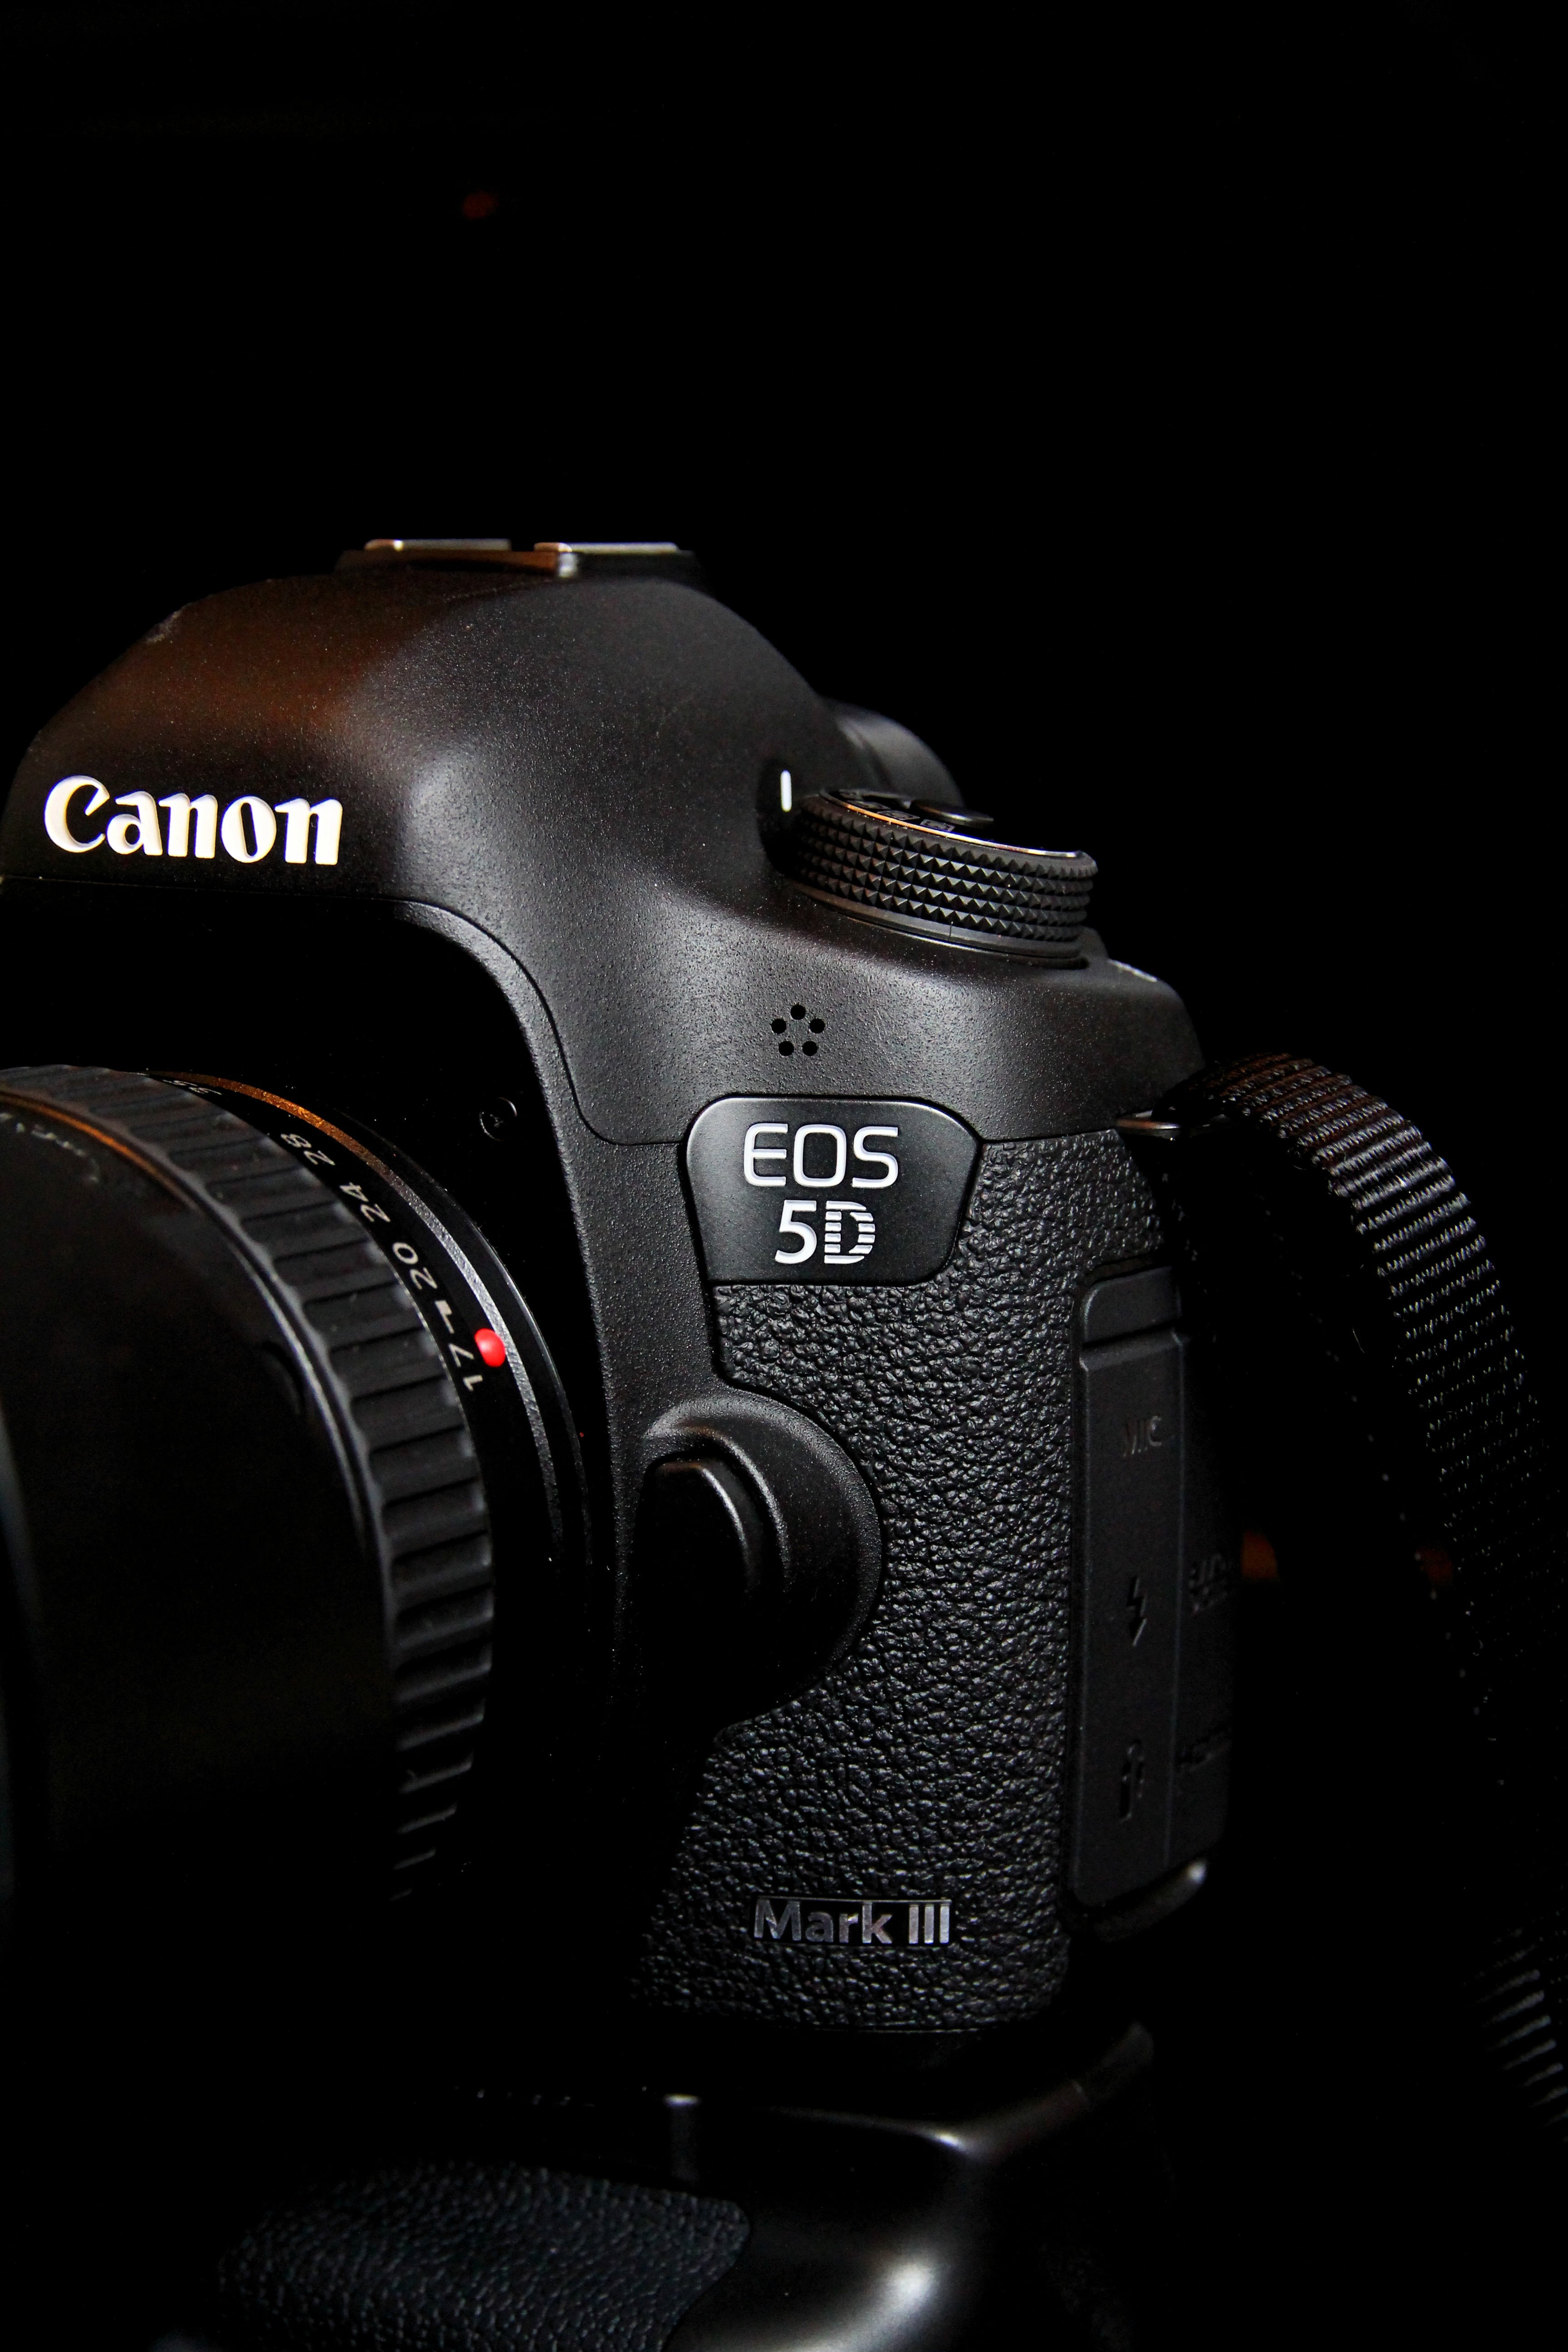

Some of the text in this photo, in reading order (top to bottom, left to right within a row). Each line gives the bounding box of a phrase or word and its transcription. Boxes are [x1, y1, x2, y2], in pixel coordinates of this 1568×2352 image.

[44, 775, 343, 866] Canon
[280, 1133, 336, 1166] 28
[743, 1122, 899, 1189] EOS
[339, 1182, 391, 1223] 24
[774, 1199, 876, 1264] 5D
[392, 1242, 438, 1290] 20
[448, 1343, 483, 1392] 17
[753, 1897, 950, 1945] Mark III
